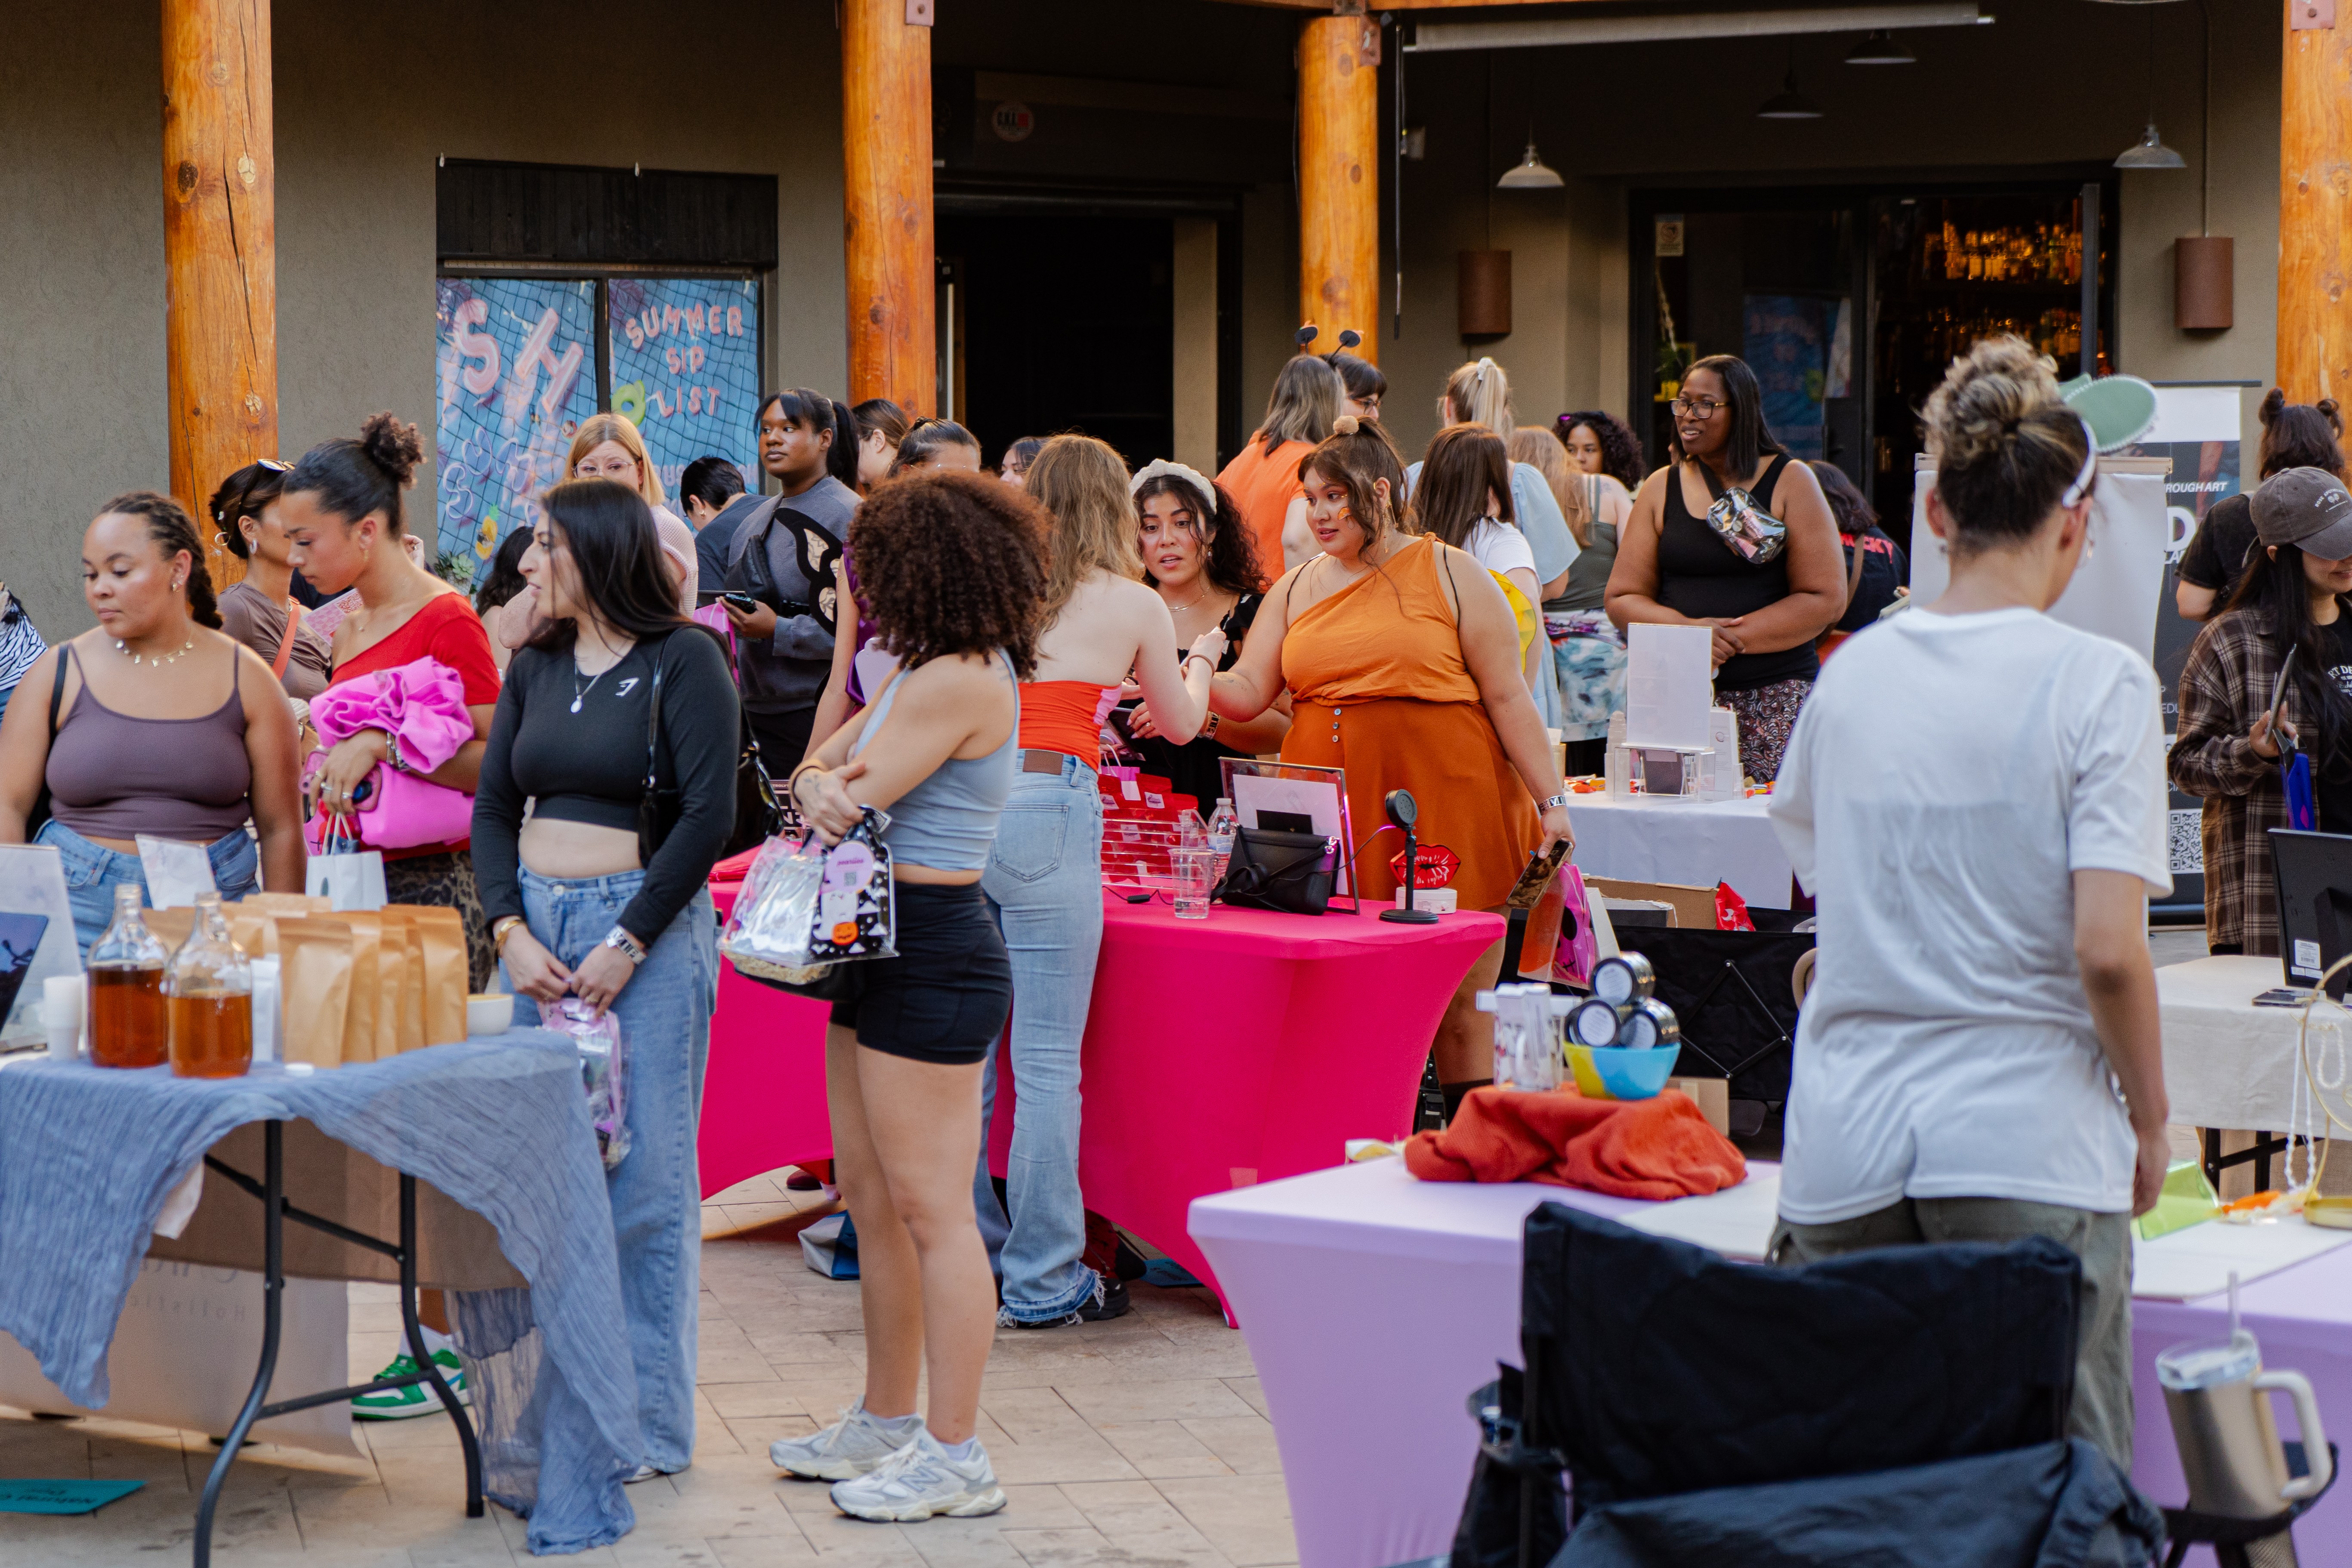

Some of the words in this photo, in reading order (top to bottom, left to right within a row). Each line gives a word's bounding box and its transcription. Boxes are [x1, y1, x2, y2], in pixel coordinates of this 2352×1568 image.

[626, 303, 743, 349] SUMMER
[666, 346, 704, 374] SIP
[656, 386, 720, 418] LIST
[2165, 482, 2204, 493] ROUGH
[2204, 481, 2228, 492] ART
[2315, 496, 2325, 507] ROSE
